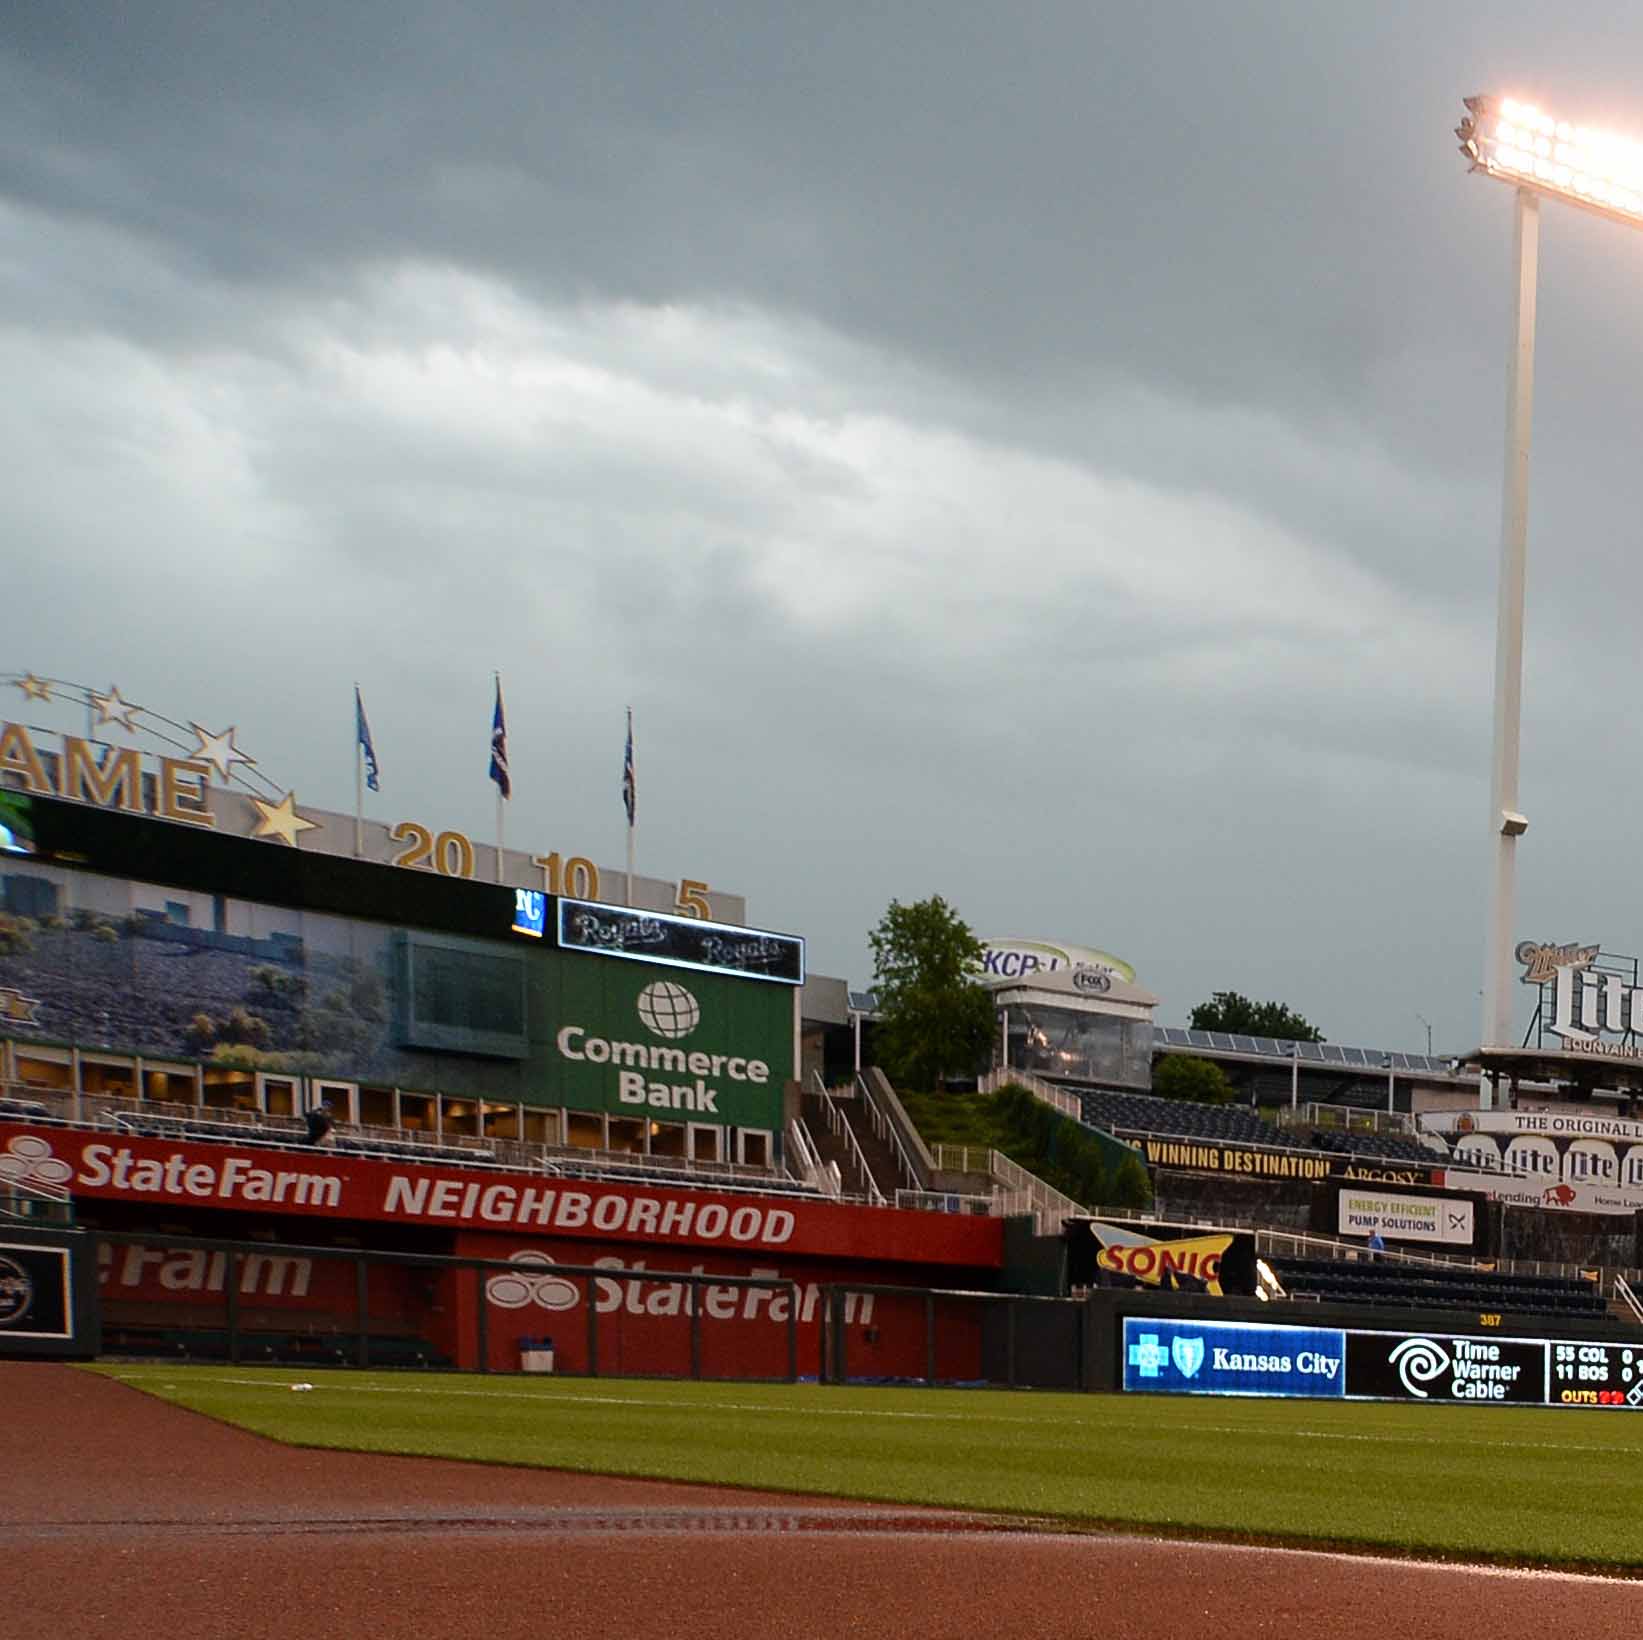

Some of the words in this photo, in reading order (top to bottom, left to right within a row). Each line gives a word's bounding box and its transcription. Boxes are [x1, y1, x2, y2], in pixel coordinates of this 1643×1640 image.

[391, 822, 474, 878] 20
[533, 852, 599, 899] 10
[674, 878, 713, 920] 5
[557, 1025, 770, 1084] Commerce
[619, 1070, 719, 1114] Bank
[1515, 1115, 1548, 1130] THE
[1552, 1117, 1631, 1138] ORIGINAL
[1146, 1140, 1220, 1169] WINNING
[1223, 1149, 1331, 1181] DESTINATION!
[1343, 1164, 1420, 1185] ARGOSY
[383, 1176, 796, 1244] NEIGHBORHOOD
[1348, 1198, 1388, 1213] ENERGY
[1390, 1200, 1436, 1217] EFFICIENT
[1348, 1214, 1379, 1227] PUMP
[1381, 1216, 1436, 1232] SOLUTIONS
[1105, 1244, 1222, 1281] SONIC
[1479, 1313, 1501, 1327] 387
[1452, 1339, 1500, 1361] Time
[1556, 1346, 1575, 1361] 55
[1578, 1346, 1609, 1363] COL
[1622, 1349, 1633, 1365] 0
[1212, 1347, 1292, 1373] Kansas
[1295, 1351, 1341, 1380] City
[1452, 1359, 1521, 1381] Warner
[1556, 1364, 1574, 1380] 11
[1578, 1365, 1609, 1381] BOS
[1622, 1366, 1633, 1382] 0
[1451, 1378, 1506, 1399] Cable
[1561, 1390, 1598, 1405] OUTS
